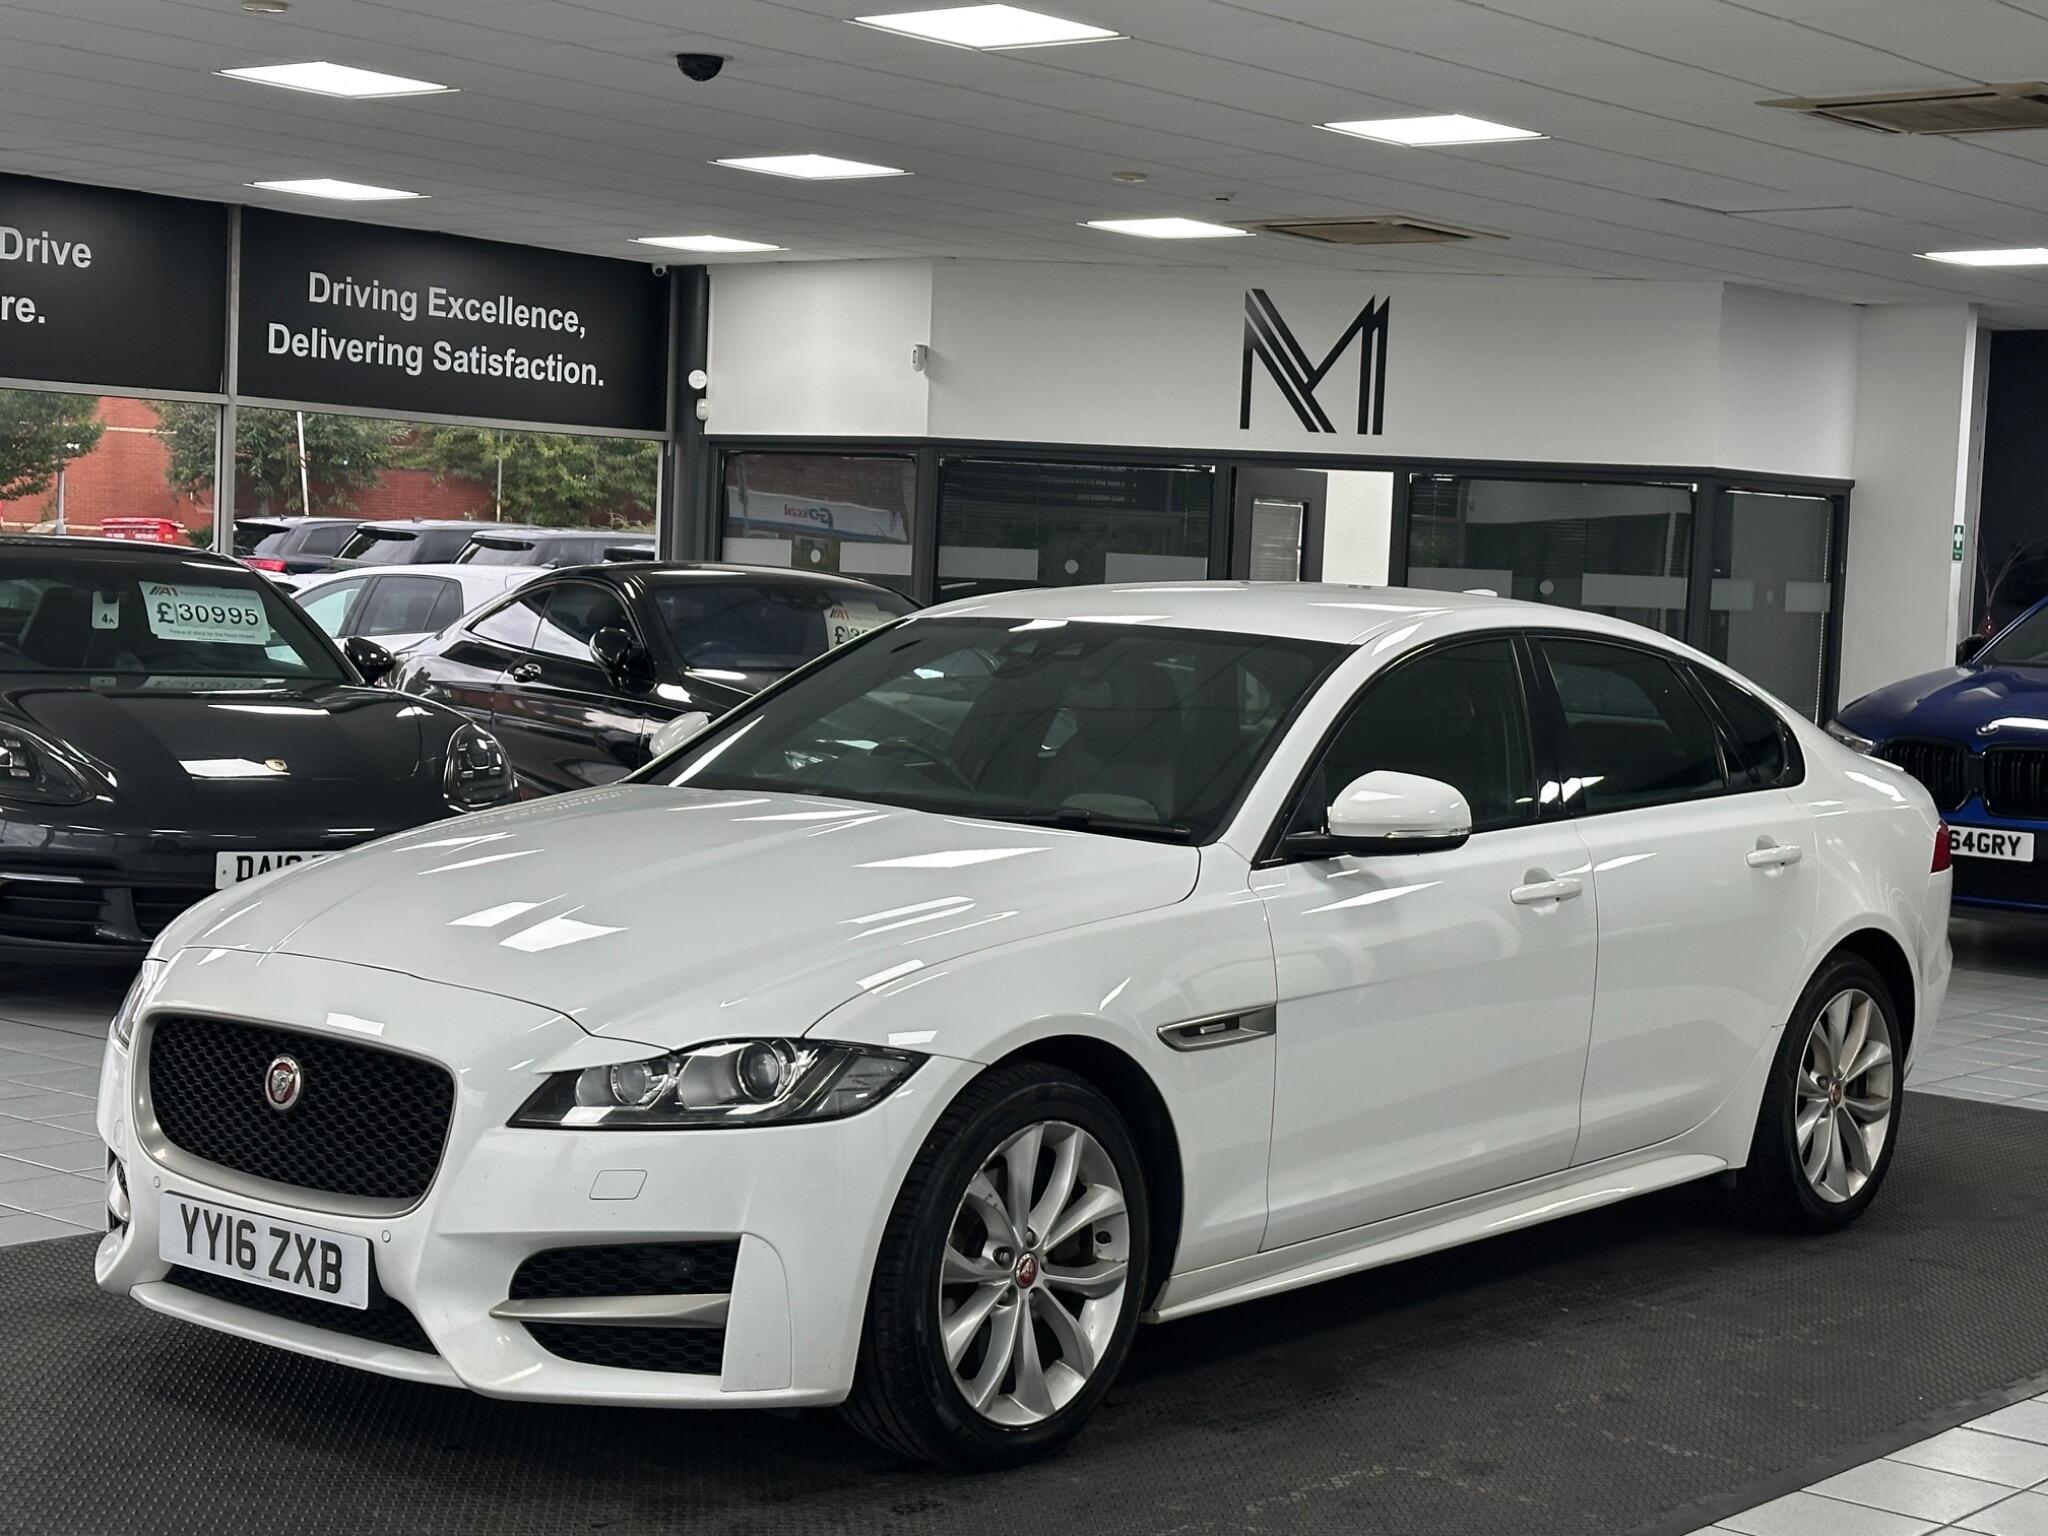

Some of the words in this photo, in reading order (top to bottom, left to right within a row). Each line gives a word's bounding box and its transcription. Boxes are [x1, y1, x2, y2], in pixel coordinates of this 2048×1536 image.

[0, 226, 92, 268] Drive
[1, 295, 45, 323] re.
[308, 271, 418, 321] Driving
[428, 286, 586, 339] Excellence,
[268, 322, 423, 376] Delivering
[432, 340, 605, 386] Satisfaction.
[156, 602, 259, 626] £30995
[1950, 829, 2021, 857] 64GRY
[180, 1203, 257, 1271] YY16
[268, 1226, 343, 1294] ZXB
